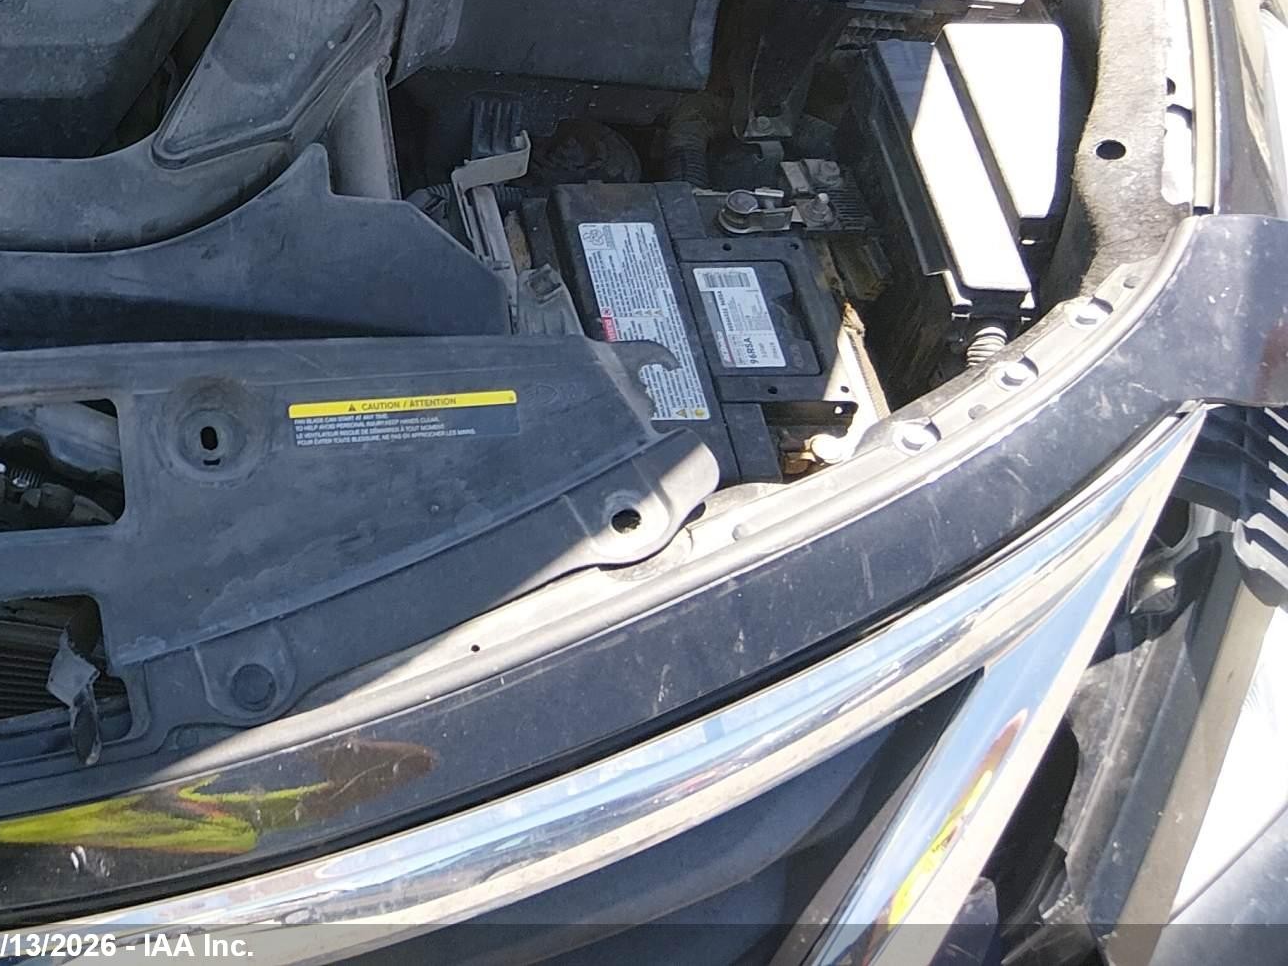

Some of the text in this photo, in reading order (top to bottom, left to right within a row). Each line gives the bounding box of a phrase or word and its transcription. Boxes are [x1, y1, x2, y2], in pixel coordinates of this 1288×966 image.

[743, 337, 760, 364] 96RSA
[361, 401, 400, 411] CAUTION
[409, 397, 457, 407] ATTENTION
[318, 423, 336, 431] AVOID
[303, 431, 339, 439] VENTILATEUR
